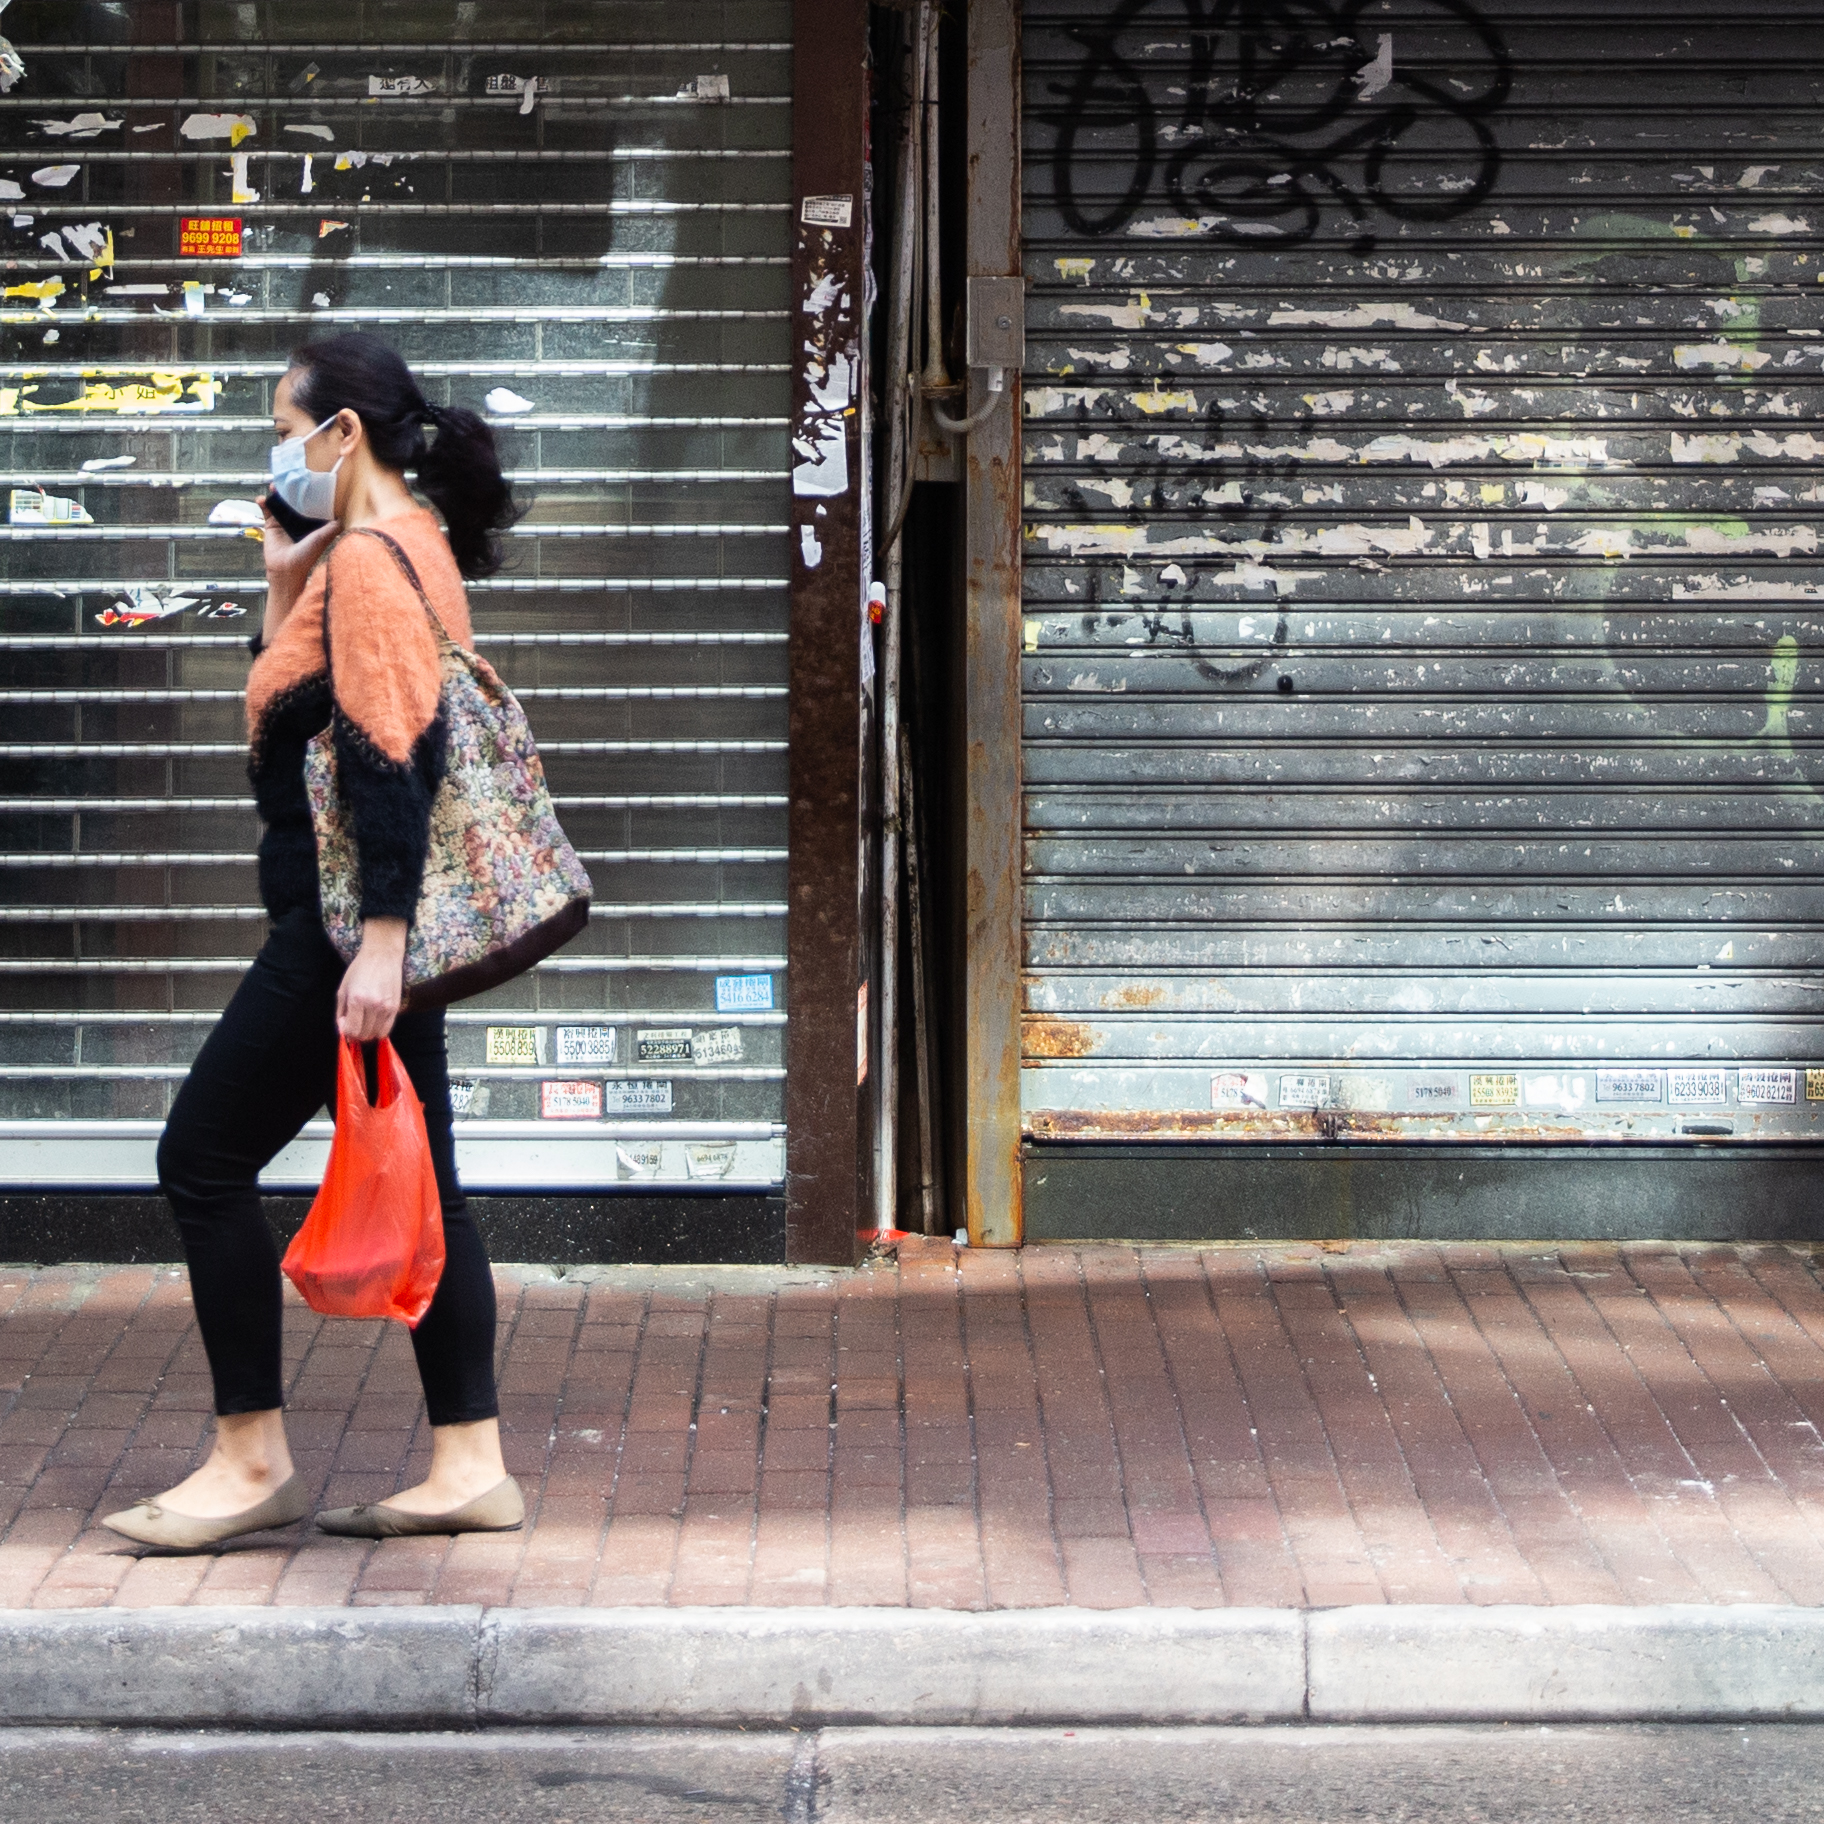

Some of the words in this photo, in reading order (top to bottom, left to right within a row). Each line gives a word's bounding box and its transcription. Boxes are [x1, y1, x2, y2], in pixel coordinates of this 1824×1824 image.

[182, 232, 210, 244] 9699
[212, 232, 240, 244] 9208
[719, 992, 743, 1004] 5416
[746, 991, 770, 1003] 6284
[640, 1042, 691, 1056] 52288971
[1612, 1083, 1633, 1092] 9633
[1635, 1083, 1655, 1092] 7802
[622, 1094, 642, 1104] 9633
[644, 1094, 666, 1104] 7802
